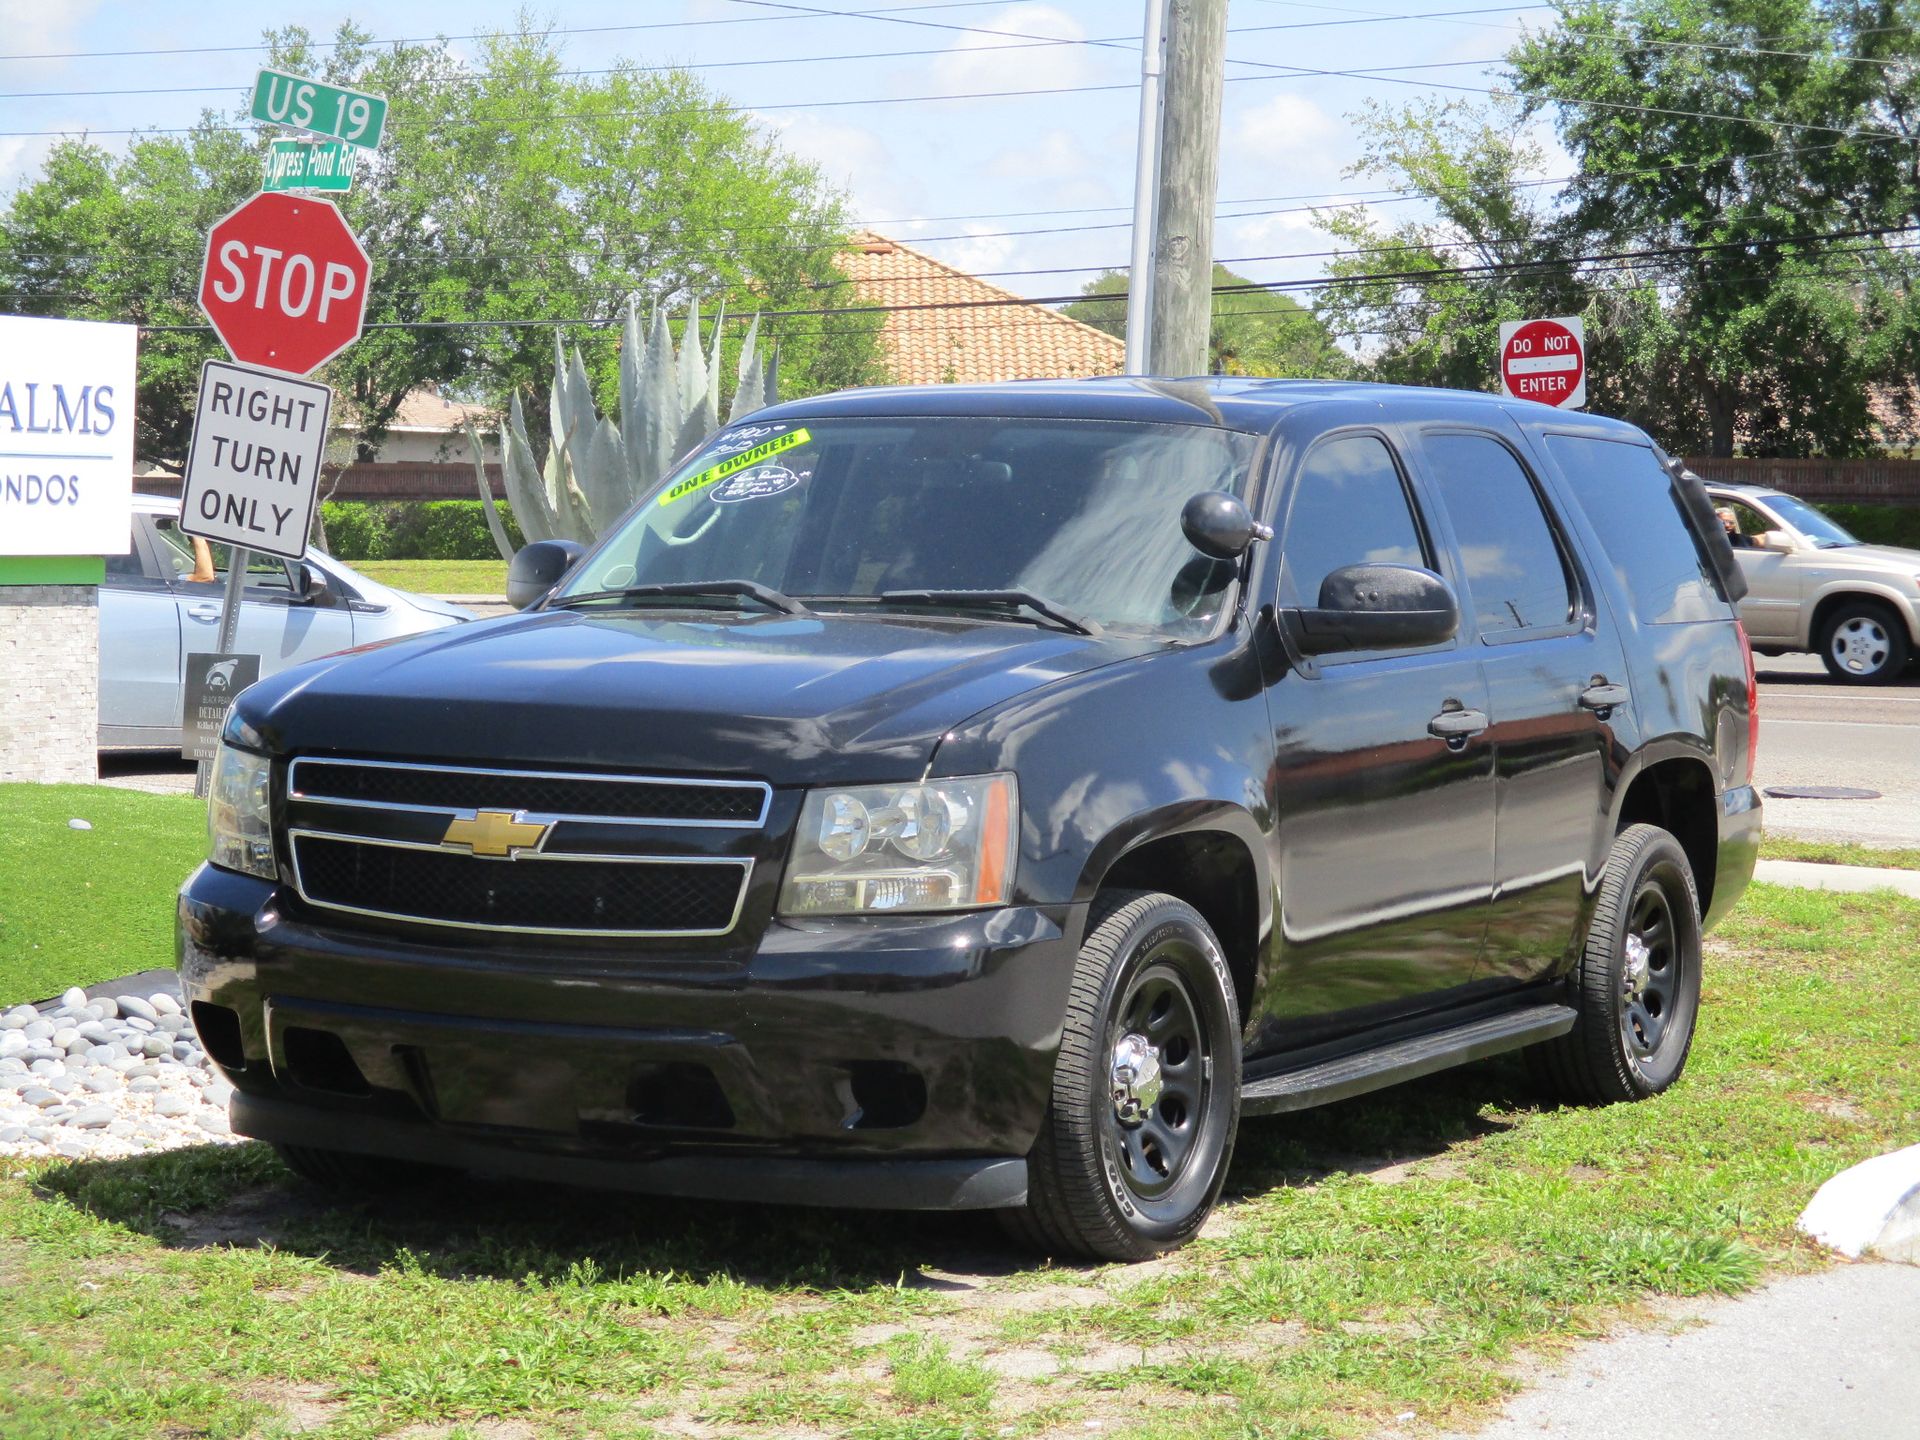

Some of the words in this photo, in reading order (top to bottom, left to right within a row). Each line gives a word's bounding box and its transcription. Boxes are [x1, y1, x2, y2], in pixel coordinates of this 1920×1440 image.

[267, 76, 316, 129] US
[334, 95, 370, 140] 19
[267, 145, 305, 187] Cypress
[306, 144, 337, 176] Pond
[337, 144, 356, 176] Rd
[213, 240, 356, 323] STOP
[1513, 338, 1531, 353] DO
[1544, 336, 1571, 351] NOT
[0, 381, 115, 437] ALMS
[211, 381, 315, 432] RIGHT
[1520, 377, 1567, 393] ENTER
[212, 435, 302, 485] TURN
[669, 470, 712, 498] ONE
[718, 433, 795, 475] OWNER
[0, 474, 79, 506] NDOS
[200, 489, 293, 536] ONLY
